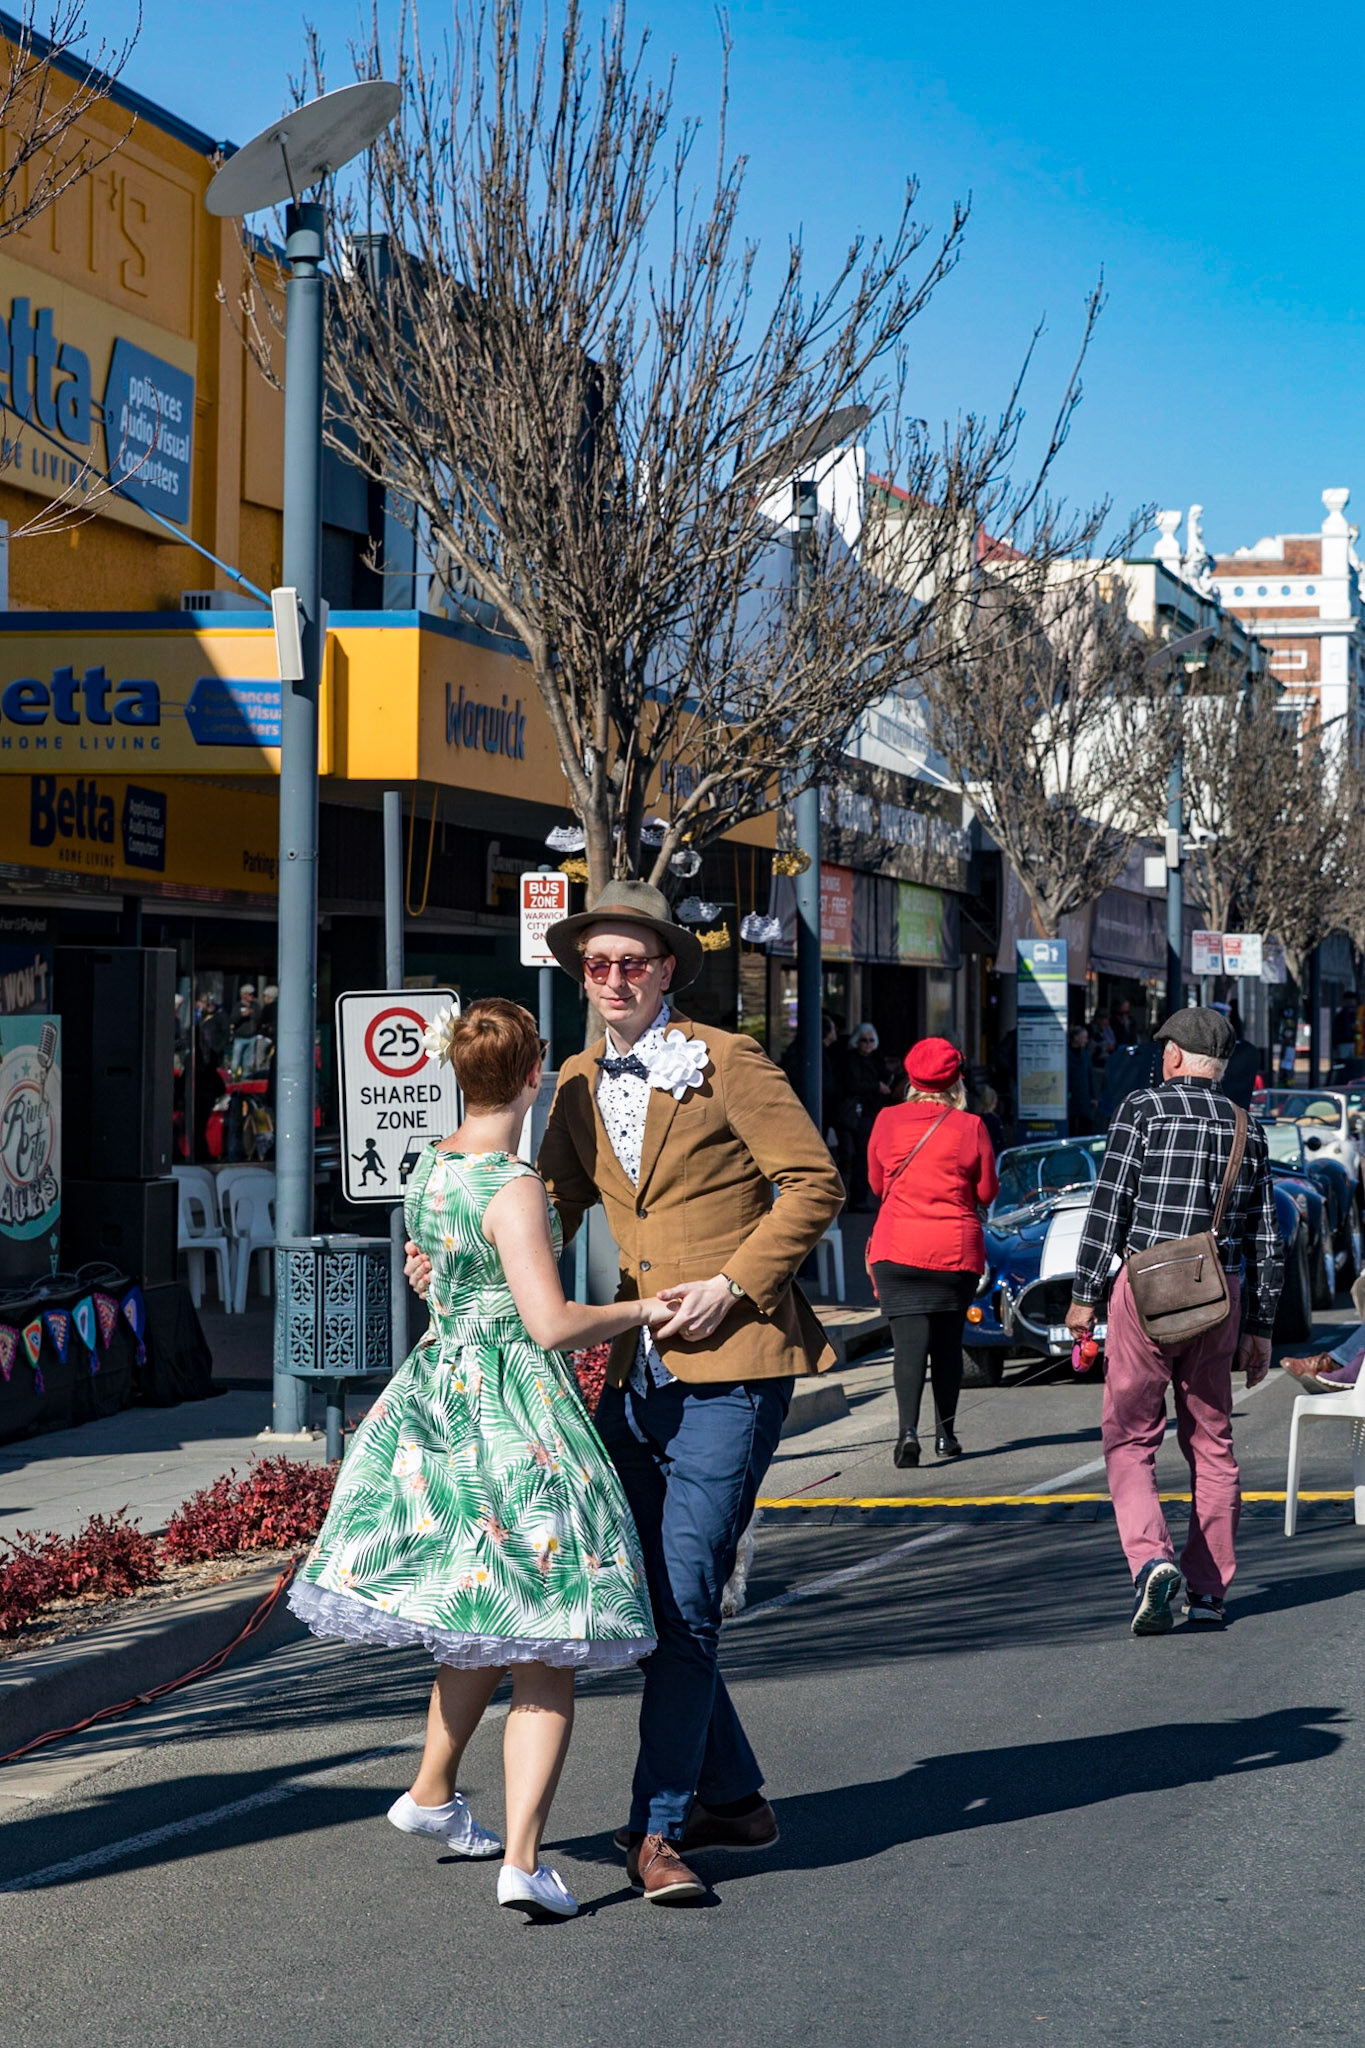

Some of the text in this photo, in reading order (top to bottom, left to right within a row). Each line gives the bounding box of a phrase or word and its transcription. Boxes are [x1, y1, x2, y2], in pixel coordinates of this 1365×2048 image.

[120, 402, 190, 464] Audio Visual
[118, 441, 179, 496] Computers
[445, 682, 526, 760] Warwick
[2, 736, 161, 750] HOME LIVING
[29, 775, 115, 848] Betta
[128, 799, 161, 820] Appliances
[128, 817, 165, 839] Audio Visual
[58, 847, 115, 869] HOME LIVING
[127, 836, 160, 858] Computers
[528, 881, 560, 895] BUS
[530, 896, 559, 909] ZONE
[524, 911, 565, 921] WARWICK
[526, 922, 547, 931] CITY
[4, 952, 49, 1013] WON'T
[378, 1027, 420, 1057] 25
[360, 1084, 442, 1105] SHARED
[1, 1094, 51, 1151] River
[376, 1110, 428, 1130] ZONE
[16, 1120, 47, 1180] City
